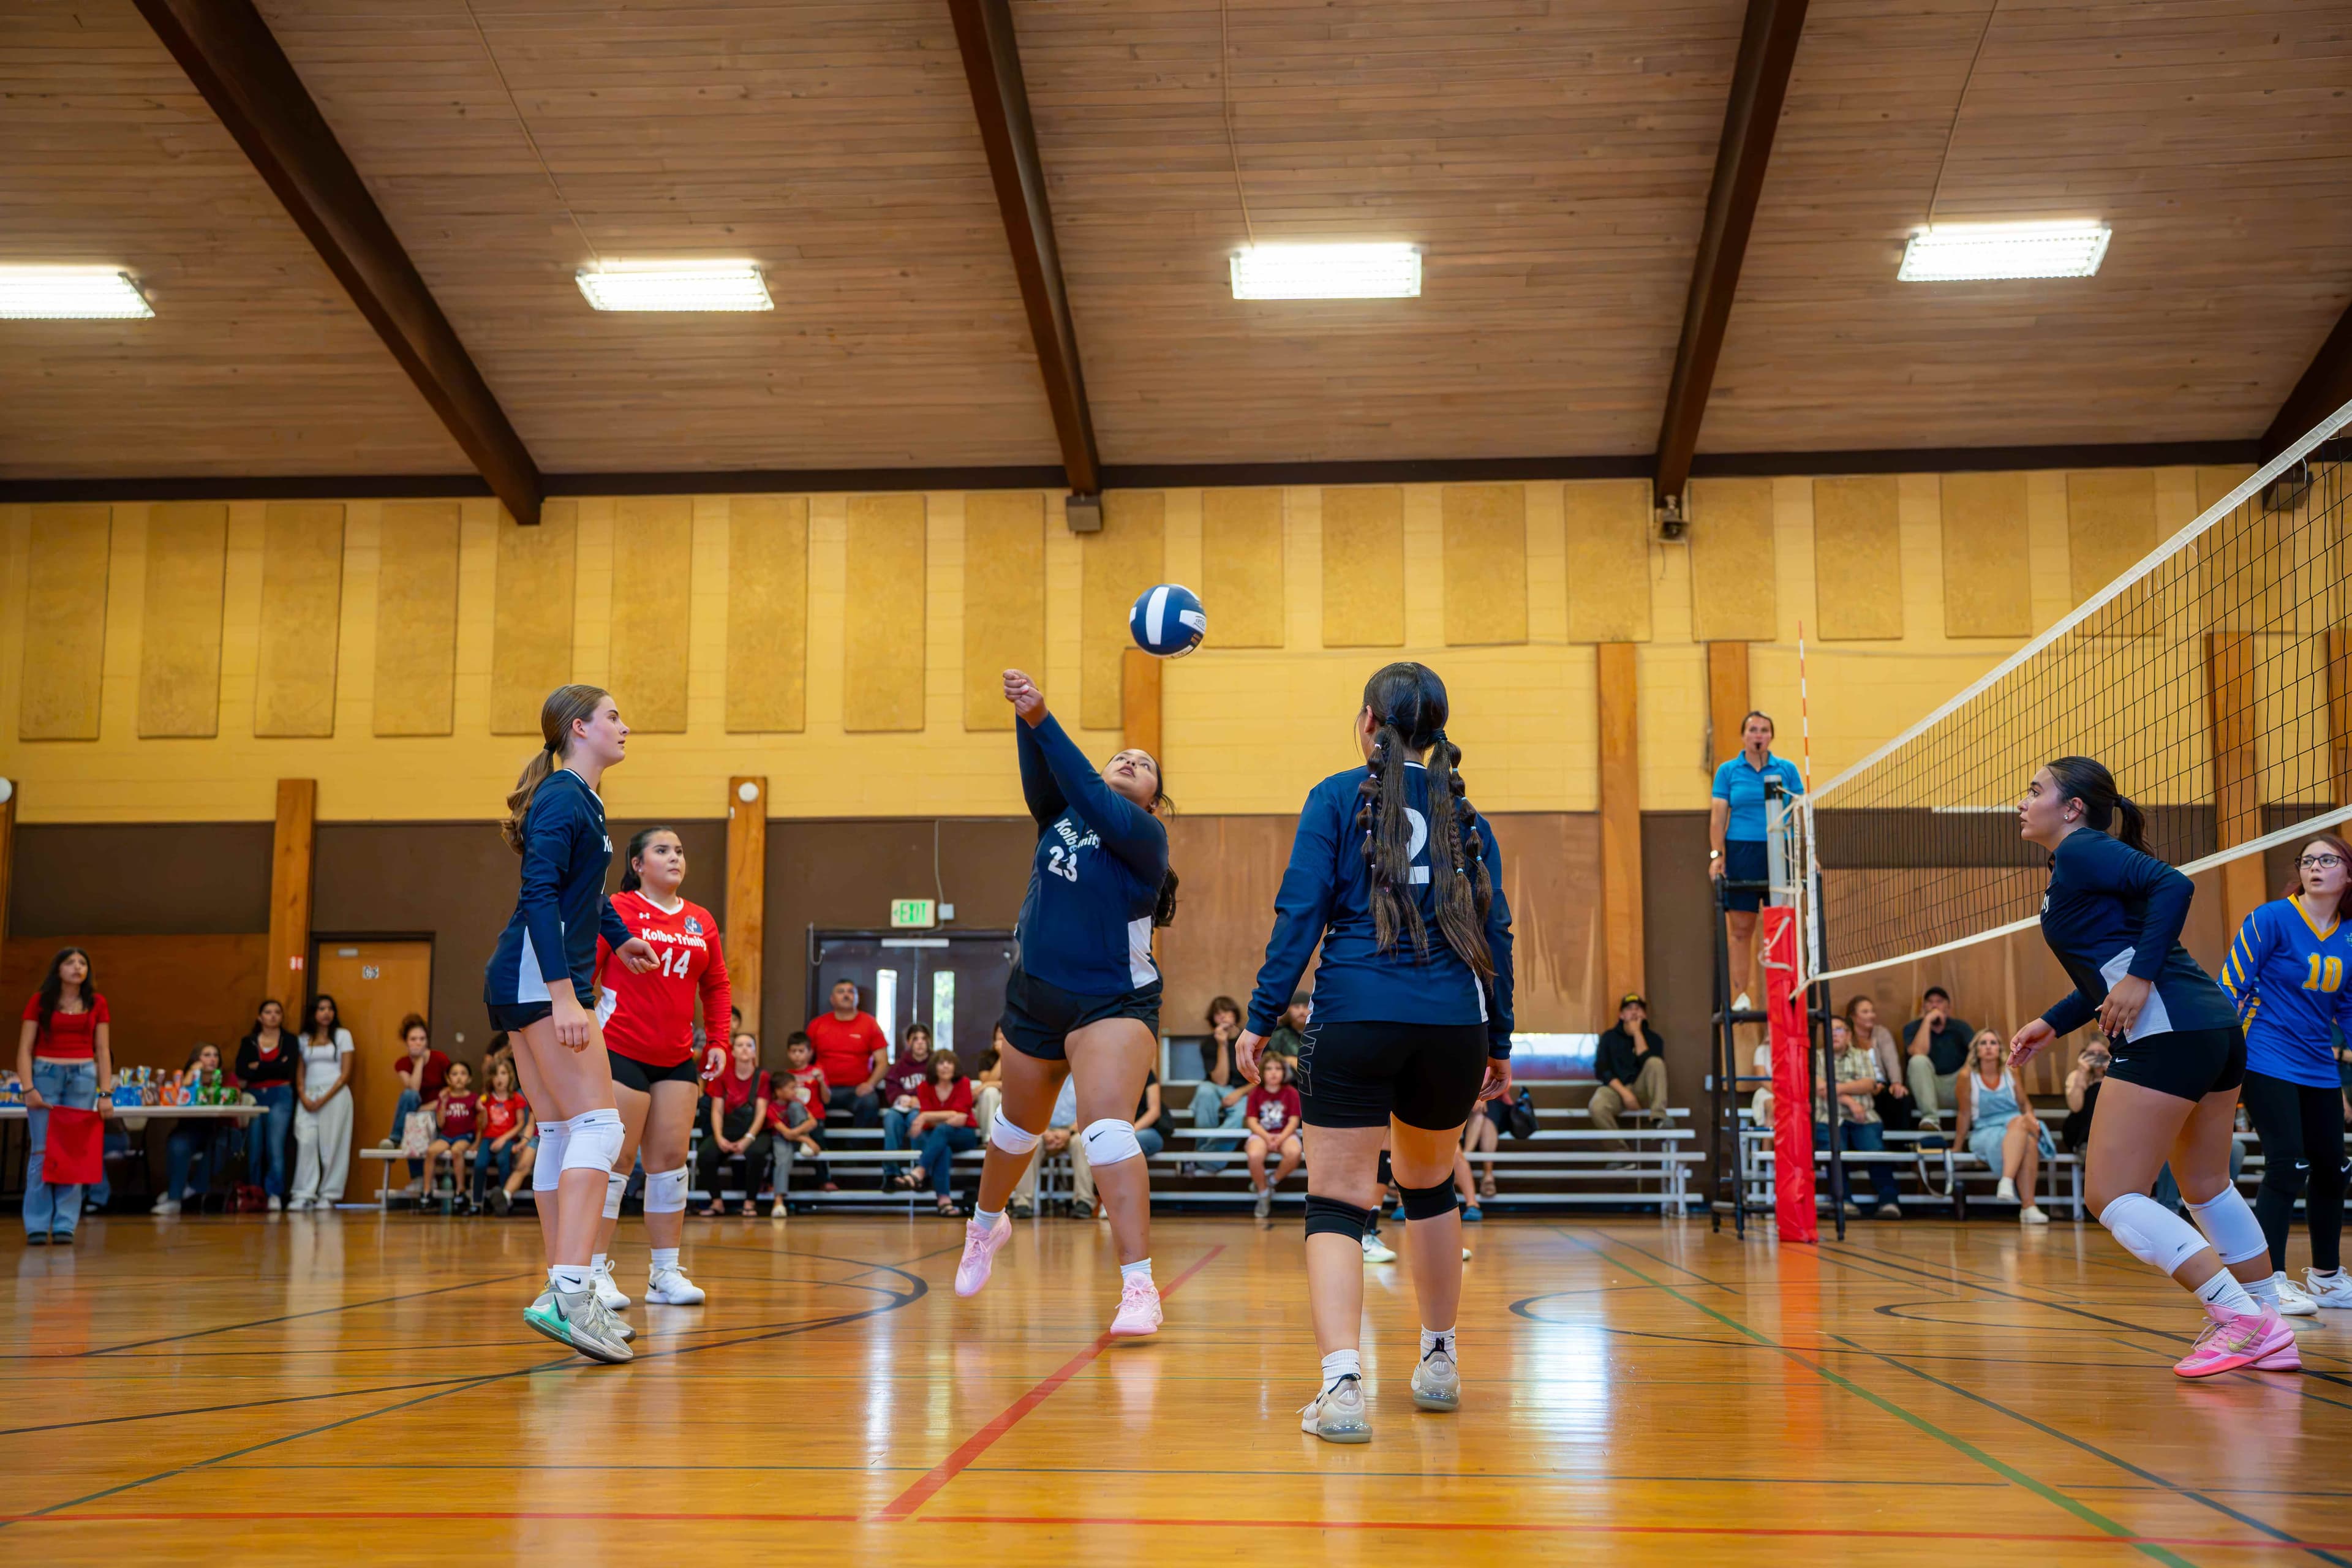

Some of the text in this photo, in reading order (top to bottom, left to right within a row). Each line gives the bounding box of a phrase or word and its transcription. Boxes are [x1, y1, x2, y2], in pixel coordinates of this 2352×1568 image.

[1048, 846, 1077, 882] 23
[900, 902, 927, 925] EXIT
[642, 928, 707, 951] Kolbe-Trinity
[661, 947, 691, 979] 14
[2302, 952, 2343, 993] 10
